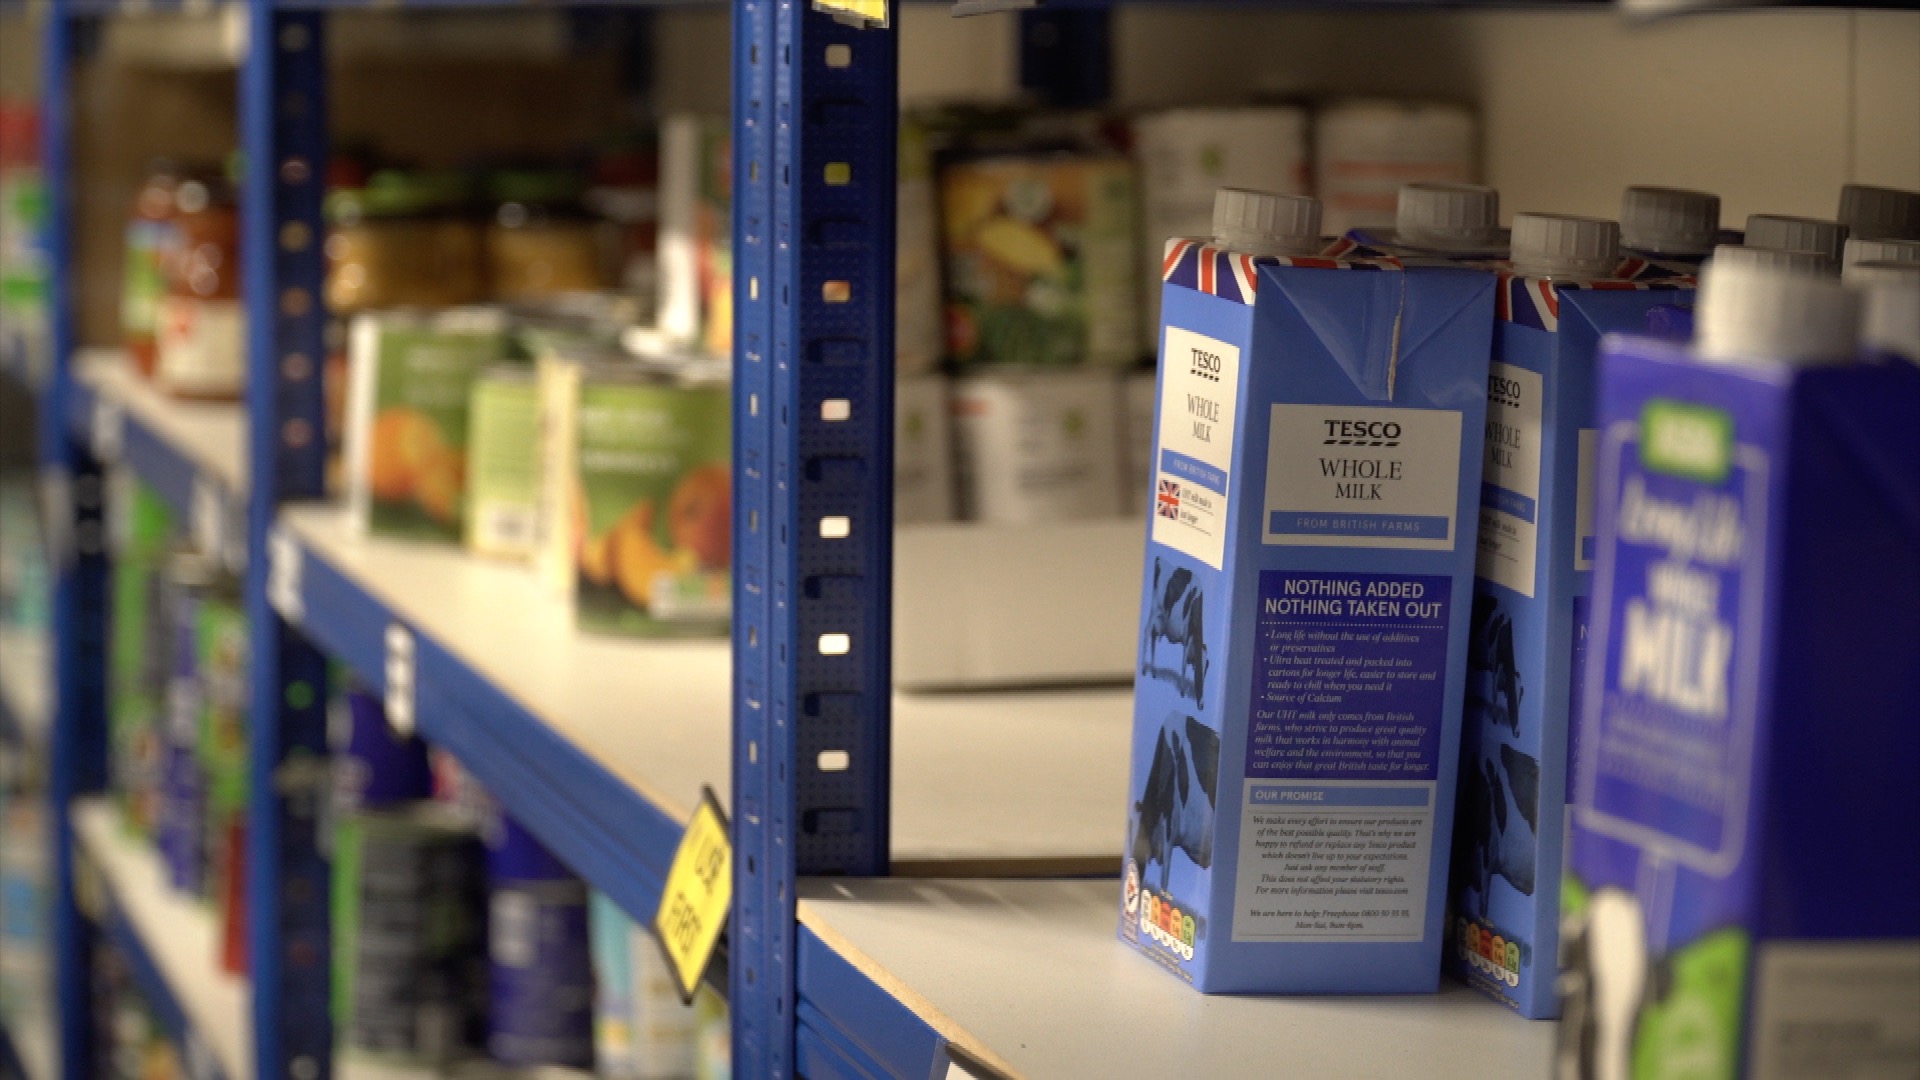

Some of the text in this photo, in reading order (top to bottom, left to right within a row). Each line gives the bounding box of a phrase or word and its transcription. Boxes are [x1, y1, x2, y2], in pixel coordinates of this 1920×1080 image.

[1191, 348, 1220, 373] TESCO
[1187, 394, 1219, 422] WHOLE
[1193, 422, 1211, 443] MILK
[1324, 420, 1401, 438] TESCO
[1491, 451, 1512, 468] MILK
[1318, 458, 1401, 480] WHOLE
[1335, 482, 1382, 500] MILK
[1297, 518, 1420, 532] FROM BRITISH FARMS
[1285, 580, 1424, 598] NOTHING ADDED
[1265, 598, 1441, 618] NOTHING TAKEN OUT
[1271, 630, 1291, 641] Long
[1295, 630, 1305, 640] life
[1308, 631, 1338, 640] without
[1341, 632, 1353, 640] the
[1372, 632, 1382, 643] of
[1383, 633, 1420, 643] additives
[1281, 643, 1335, 654] preservatives
[1270, 656, 1290, 665] Ultra
[1294, 657, 1311, 665] heat
[1314, 657, 1343, 665] treated
[1346, 658, 1361, 666] and
[1364, 658, 1393, 668] packed
[1268, 669, 1300, 677] cartons
[1302, 668, 1312, 679] for
[1316, 669, 1341, 679] longer
[1360, 670, 1384, 678] easier
[1387, 671, 1395, 679] to
[1398, 671, 1417, 679] store
[1420, 671, 1436, 680] and
[1268, 680, 1291, 691] ready
[1304, 680, 1321, 690] chill
[1324, 681, 1345, 690] when
[1346, 683, 1362, 693] you
[1365, 682, 1384, 690] need
[1387, 683, 1392, 691] it
[1266, 693, 1342, 704] Source of Calcium
[1256, 791, 1324, 801] OUR PROMISE
